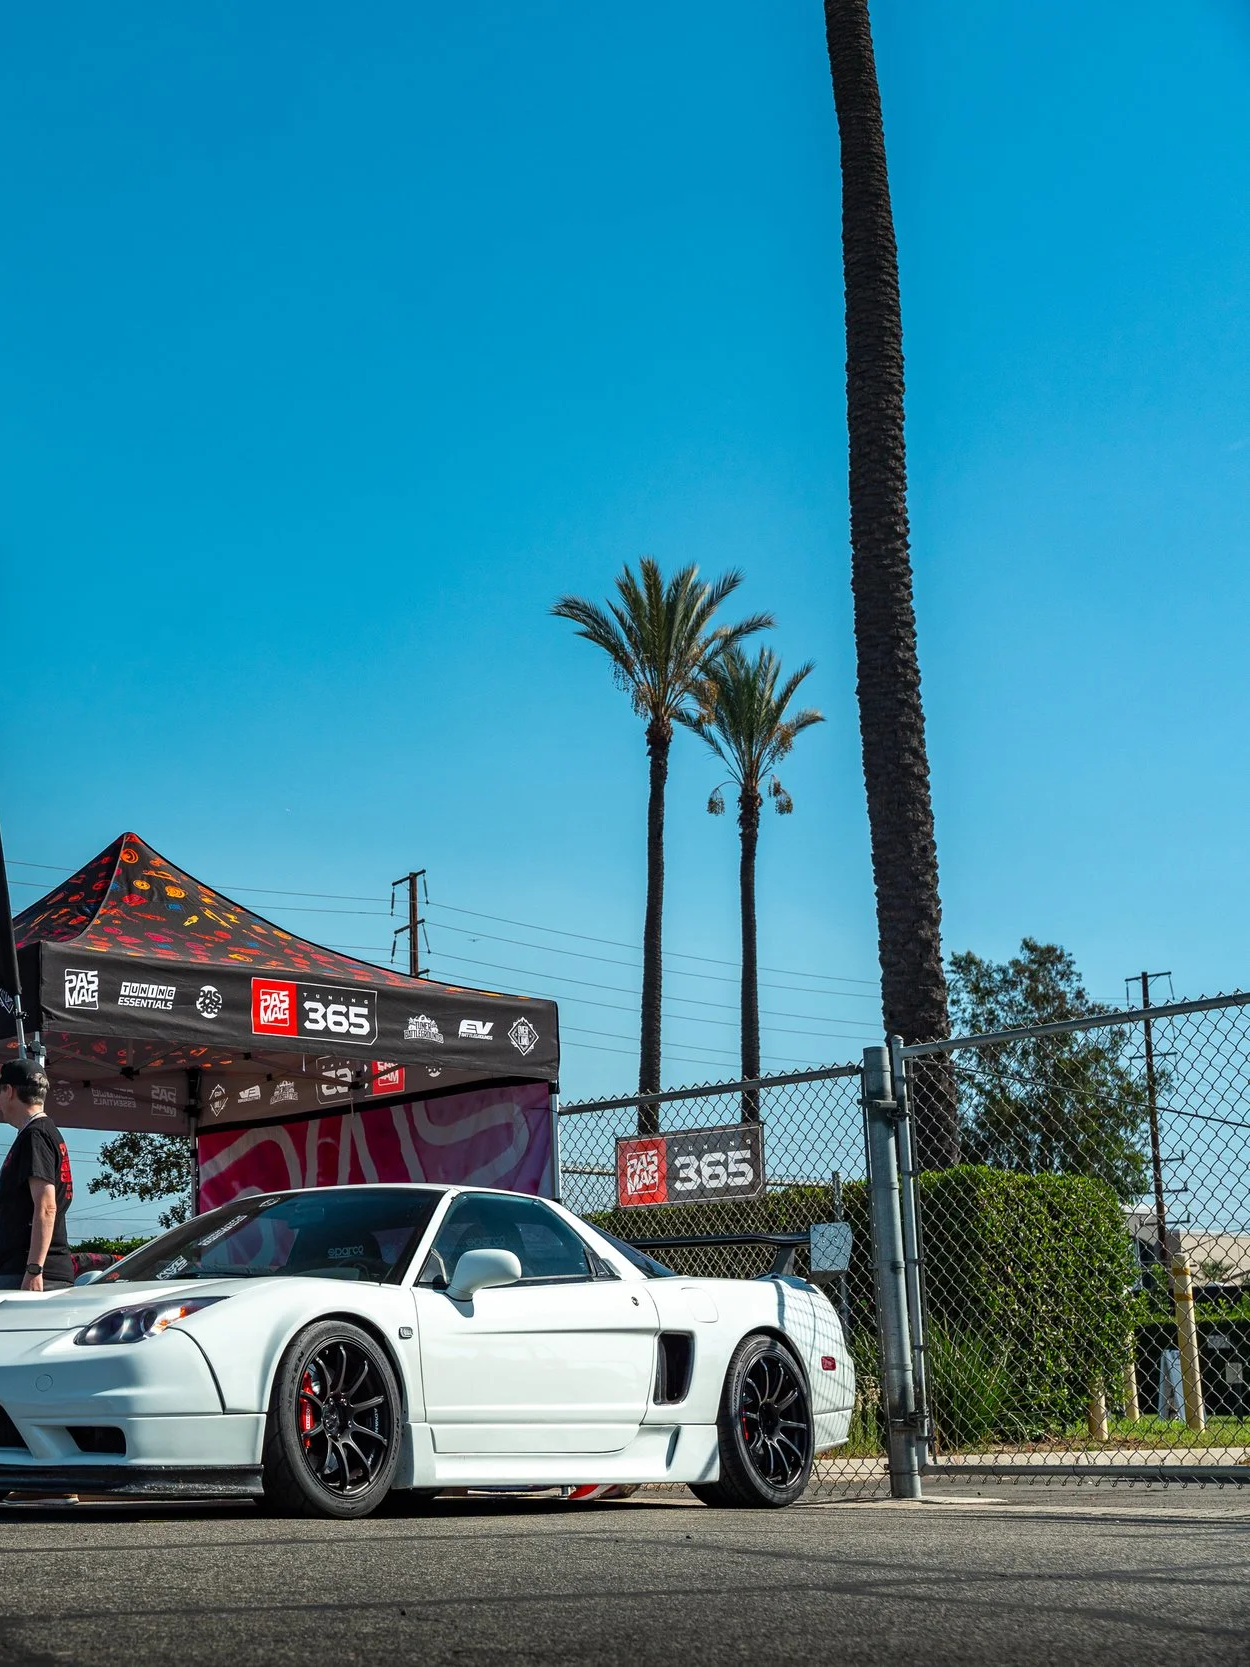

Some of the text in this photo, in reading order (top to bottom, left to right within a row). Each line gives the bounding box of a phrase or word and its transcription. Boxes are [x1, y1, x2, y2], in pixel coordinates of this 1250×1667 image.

[65, 970, 98, 991] PAS
[65, 987, 98, 1008] MAG
[121, 983, 175, 999] TUNING
[260, 990, 289, 1009] PAS
[303, 992, 369, 1005] TUNING
[118, 997, 173, 1010] ESSENTIALS
[260, 1006, 289, 1024] MAG
[303, 1001, 370, 1036] 365
[460, 1019, 494, 1035] EV
[674, 1139, 751, 1152] TUNING
[627, 1150, 658, 1172] PAS
[674, 1150, 753, 1191] 365
[628, 1169, 658, 1194] MAG
[328, 1246, 364, 1260] sparco
